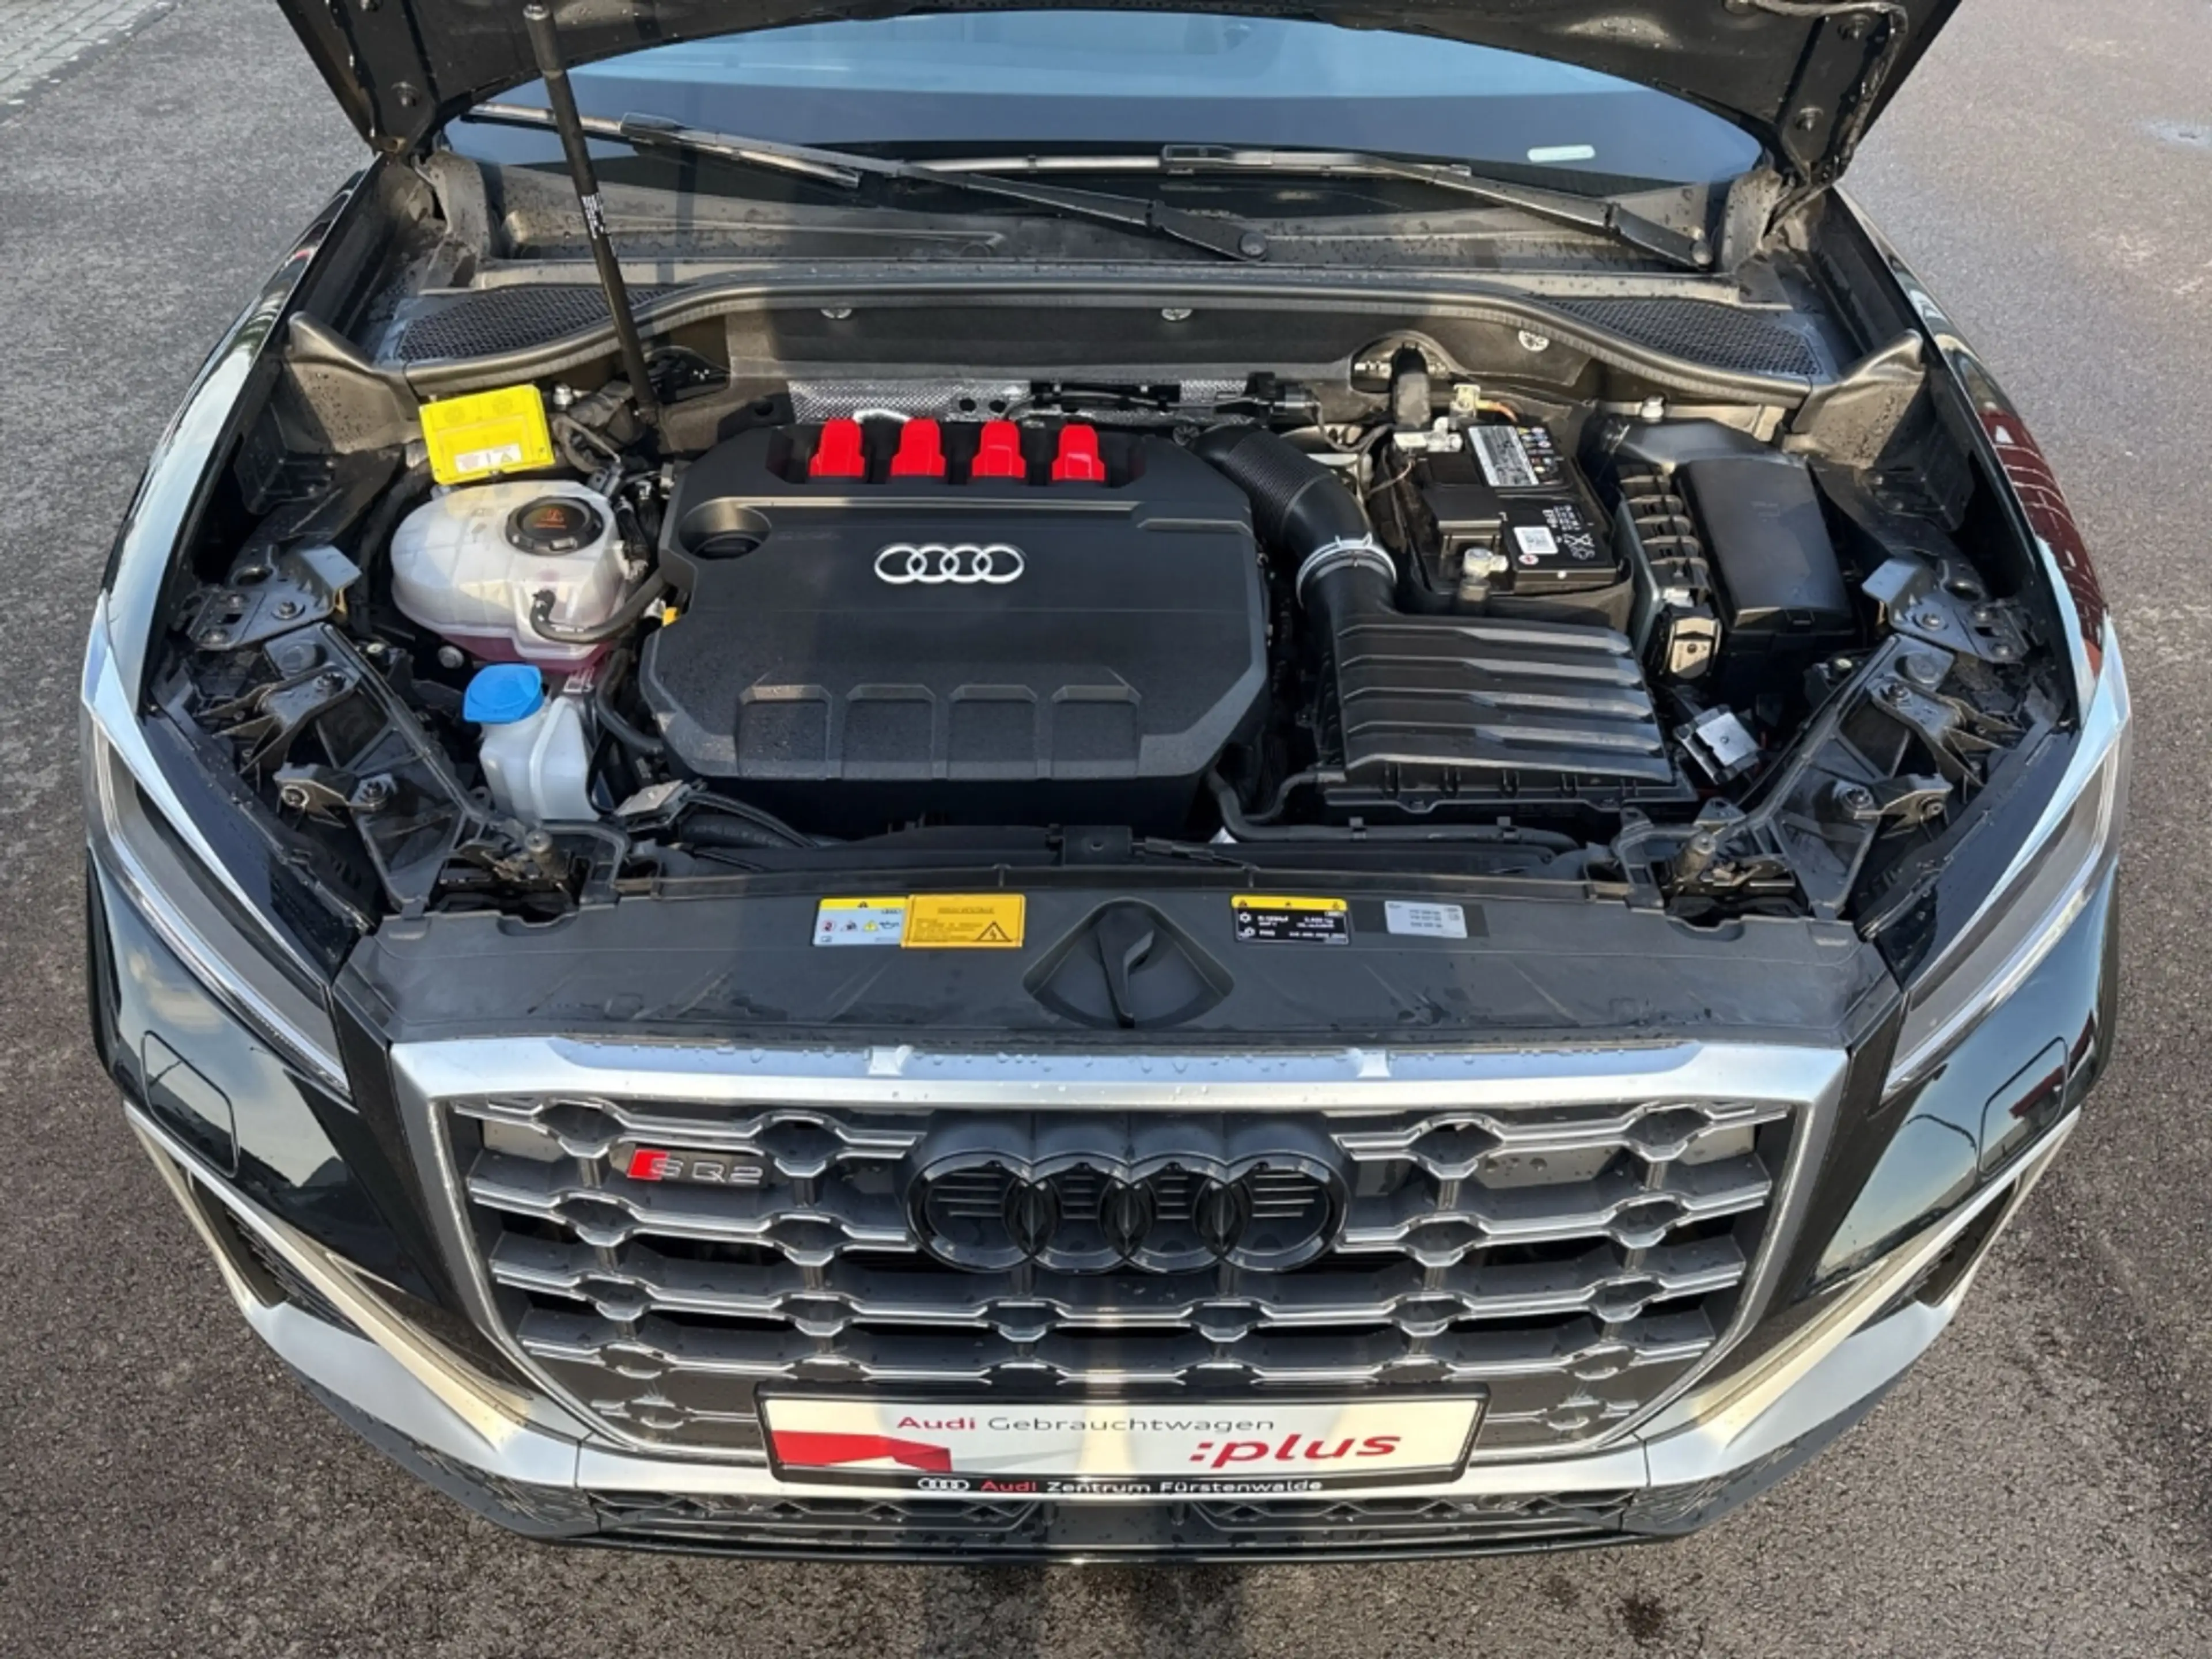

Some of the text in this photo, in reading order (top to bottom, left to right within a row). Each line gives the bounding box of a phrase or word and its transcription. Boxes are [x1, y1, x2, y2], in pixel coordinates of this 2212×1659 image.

[650, 1158, 763, 1184] SQ2
[897, 1416, 1274, 1433] Audi Gebrauchtwagen
[980, 1479, 1324, 1494] Audi Zentrum Fürstenwalde
